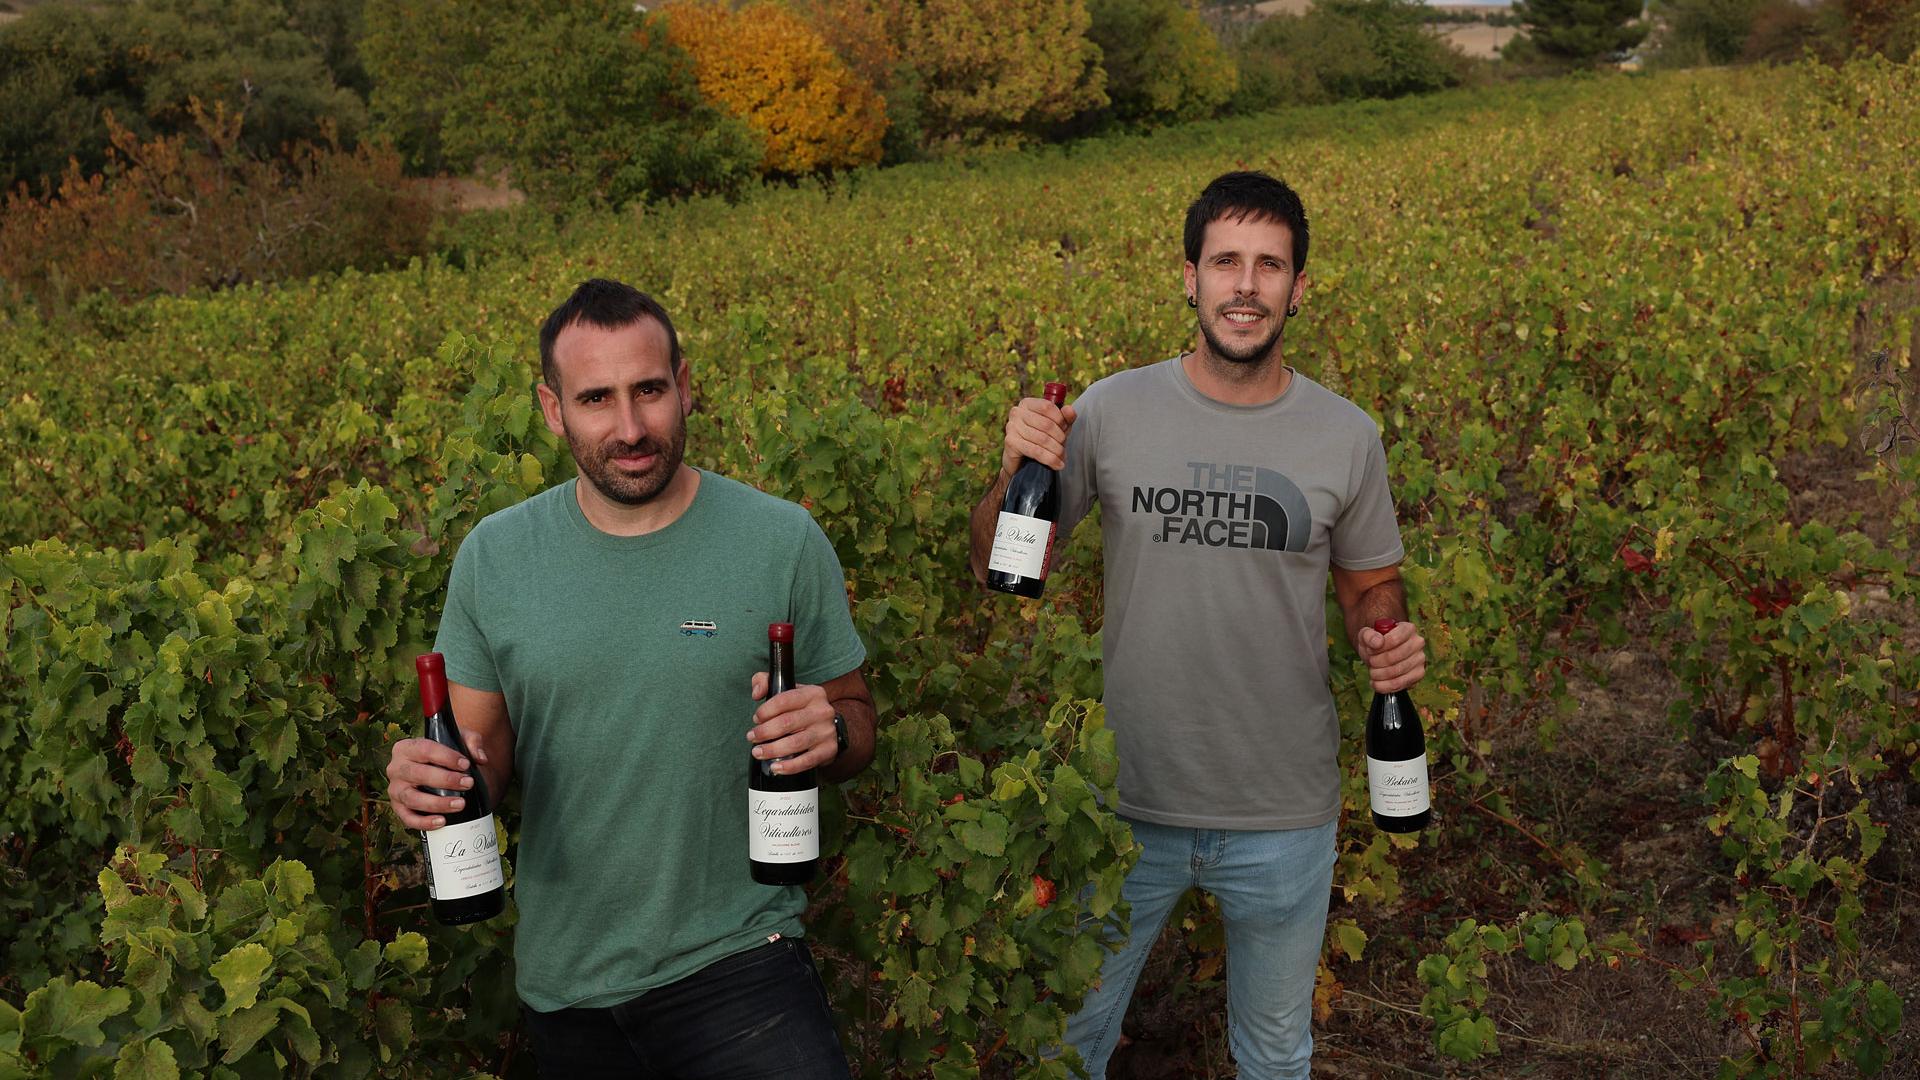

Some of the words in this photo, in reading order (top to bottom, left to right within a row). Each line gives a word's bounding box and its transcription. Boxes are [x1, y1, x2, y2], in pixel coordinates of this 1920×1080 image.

[1187, 461, 1254, 493] THE
[1132, 486, 1252, 521] NORTH
[1162, 516, 1250, 549] FACE
[444, 839, 466, 859] La
